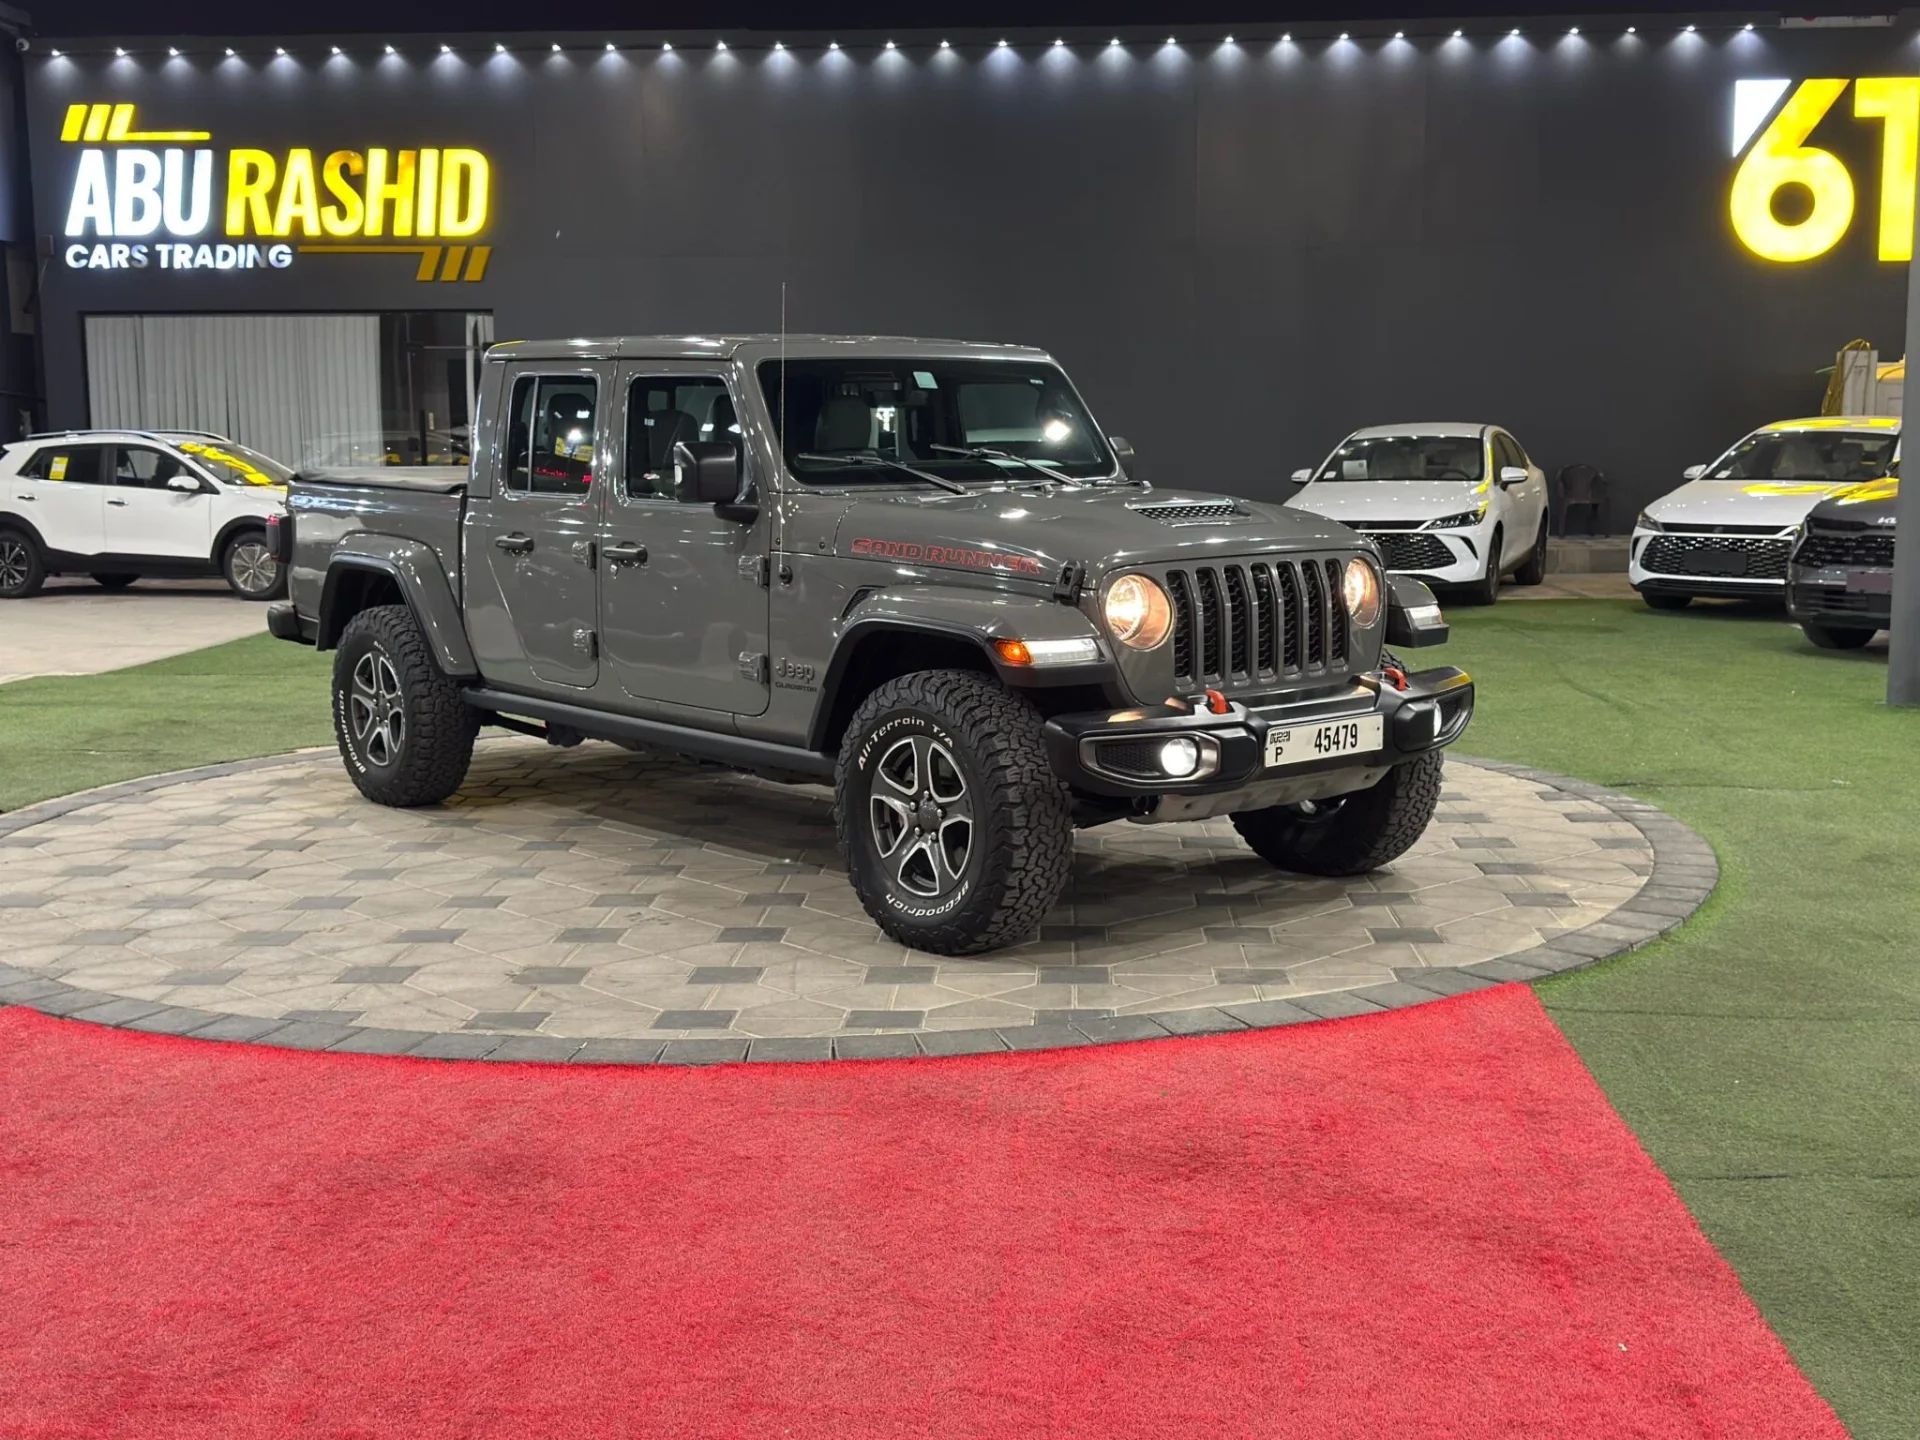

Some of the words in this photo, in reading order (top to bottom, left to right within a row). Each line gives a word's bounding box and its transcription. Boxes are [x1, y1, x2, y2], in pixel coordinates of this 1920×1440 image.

[64, 148, 213, 237] ABU
[225, 148, 490, 237] RASHID
[65, 243, 149, 269] CARS
[155, 243, 293, 269] TRADING
[851, 537, 922, 560] SAND
[925, 544, 1040, 575] RUNNER
[775, 657, 815, 684] Jeep
[858, 716, 925, 771] All-Terrain
[932, 723, 953, 748] T/A
[1275, 746, 1284, 763] P
[1314, 723, 1358, 754] 45479
[885, 880, 969, 917] BFGoodrich
